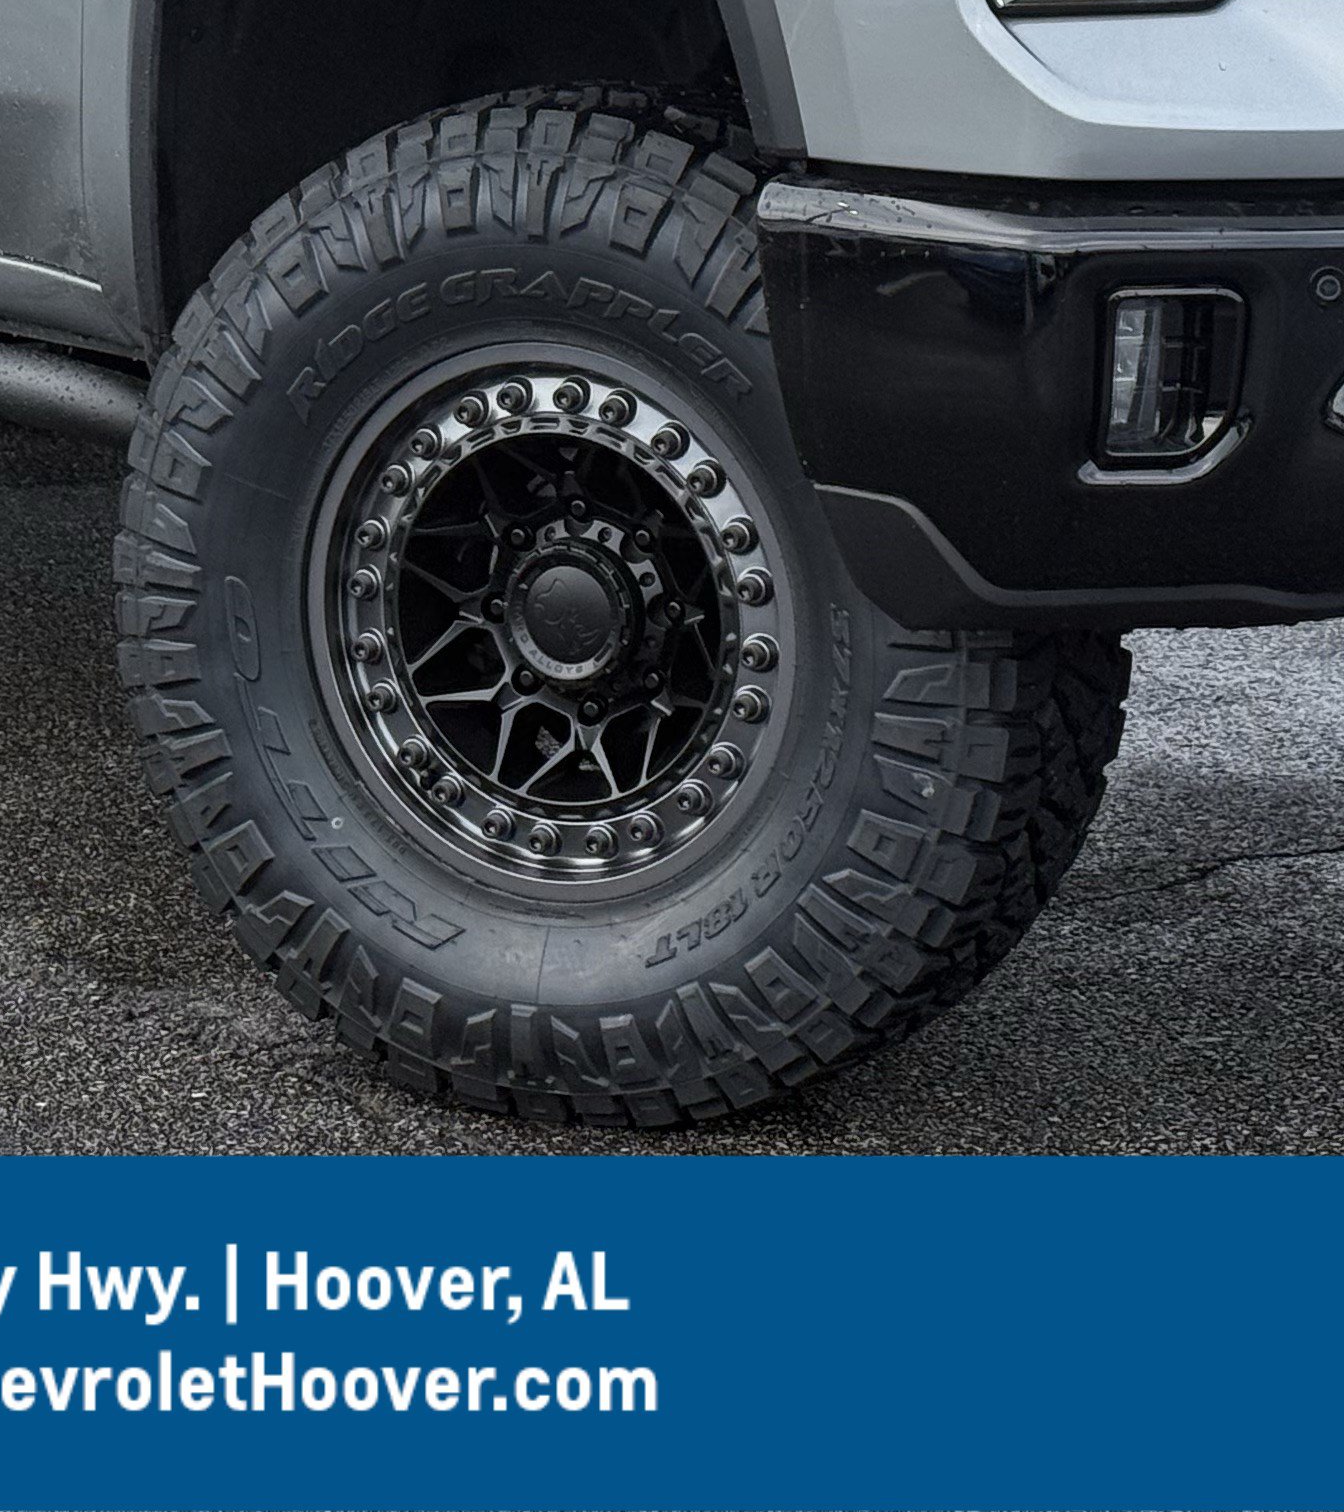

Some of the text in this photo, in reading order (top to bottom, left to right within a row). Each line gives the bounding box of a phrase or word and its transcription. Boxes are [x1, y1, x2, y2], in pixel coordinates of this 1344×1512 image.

[287, 281, 432, 426] RIDGE
[440, 267, 754, 400] GRAPPLER
[224, 575, 467, 951] NITTO
